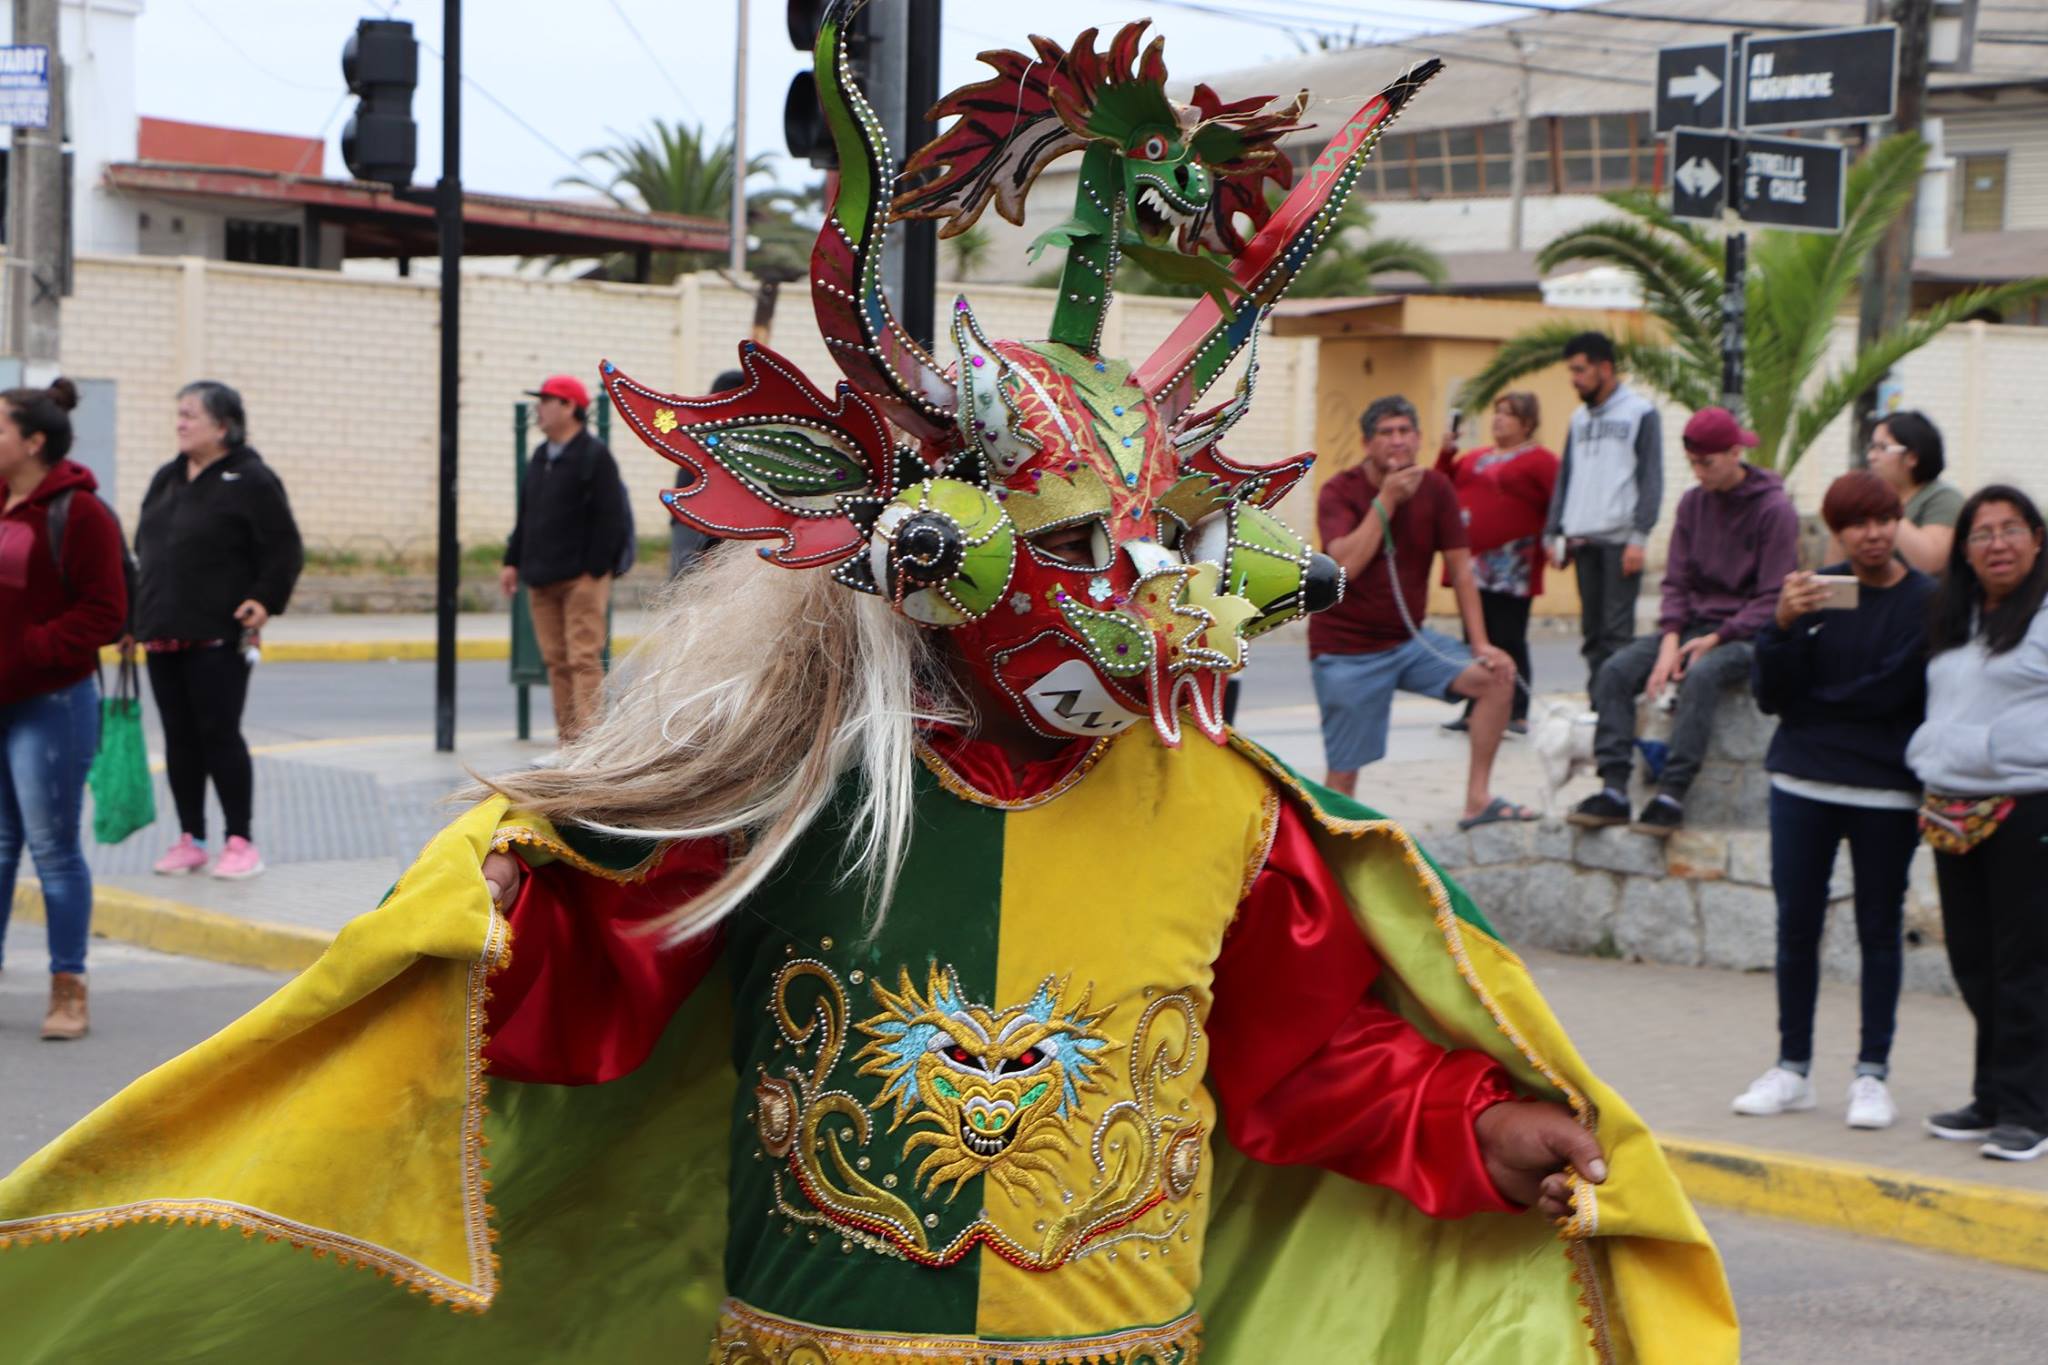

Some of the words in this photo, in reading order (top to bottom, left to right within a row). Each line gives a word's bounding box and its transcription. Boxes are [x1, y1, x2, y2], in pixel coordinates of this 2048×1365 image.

[1750, 52, 1774, 76] AV
[1746, 152, 1804, 177] STRELLA
[1770, 179, 1806, 204] CHILE
